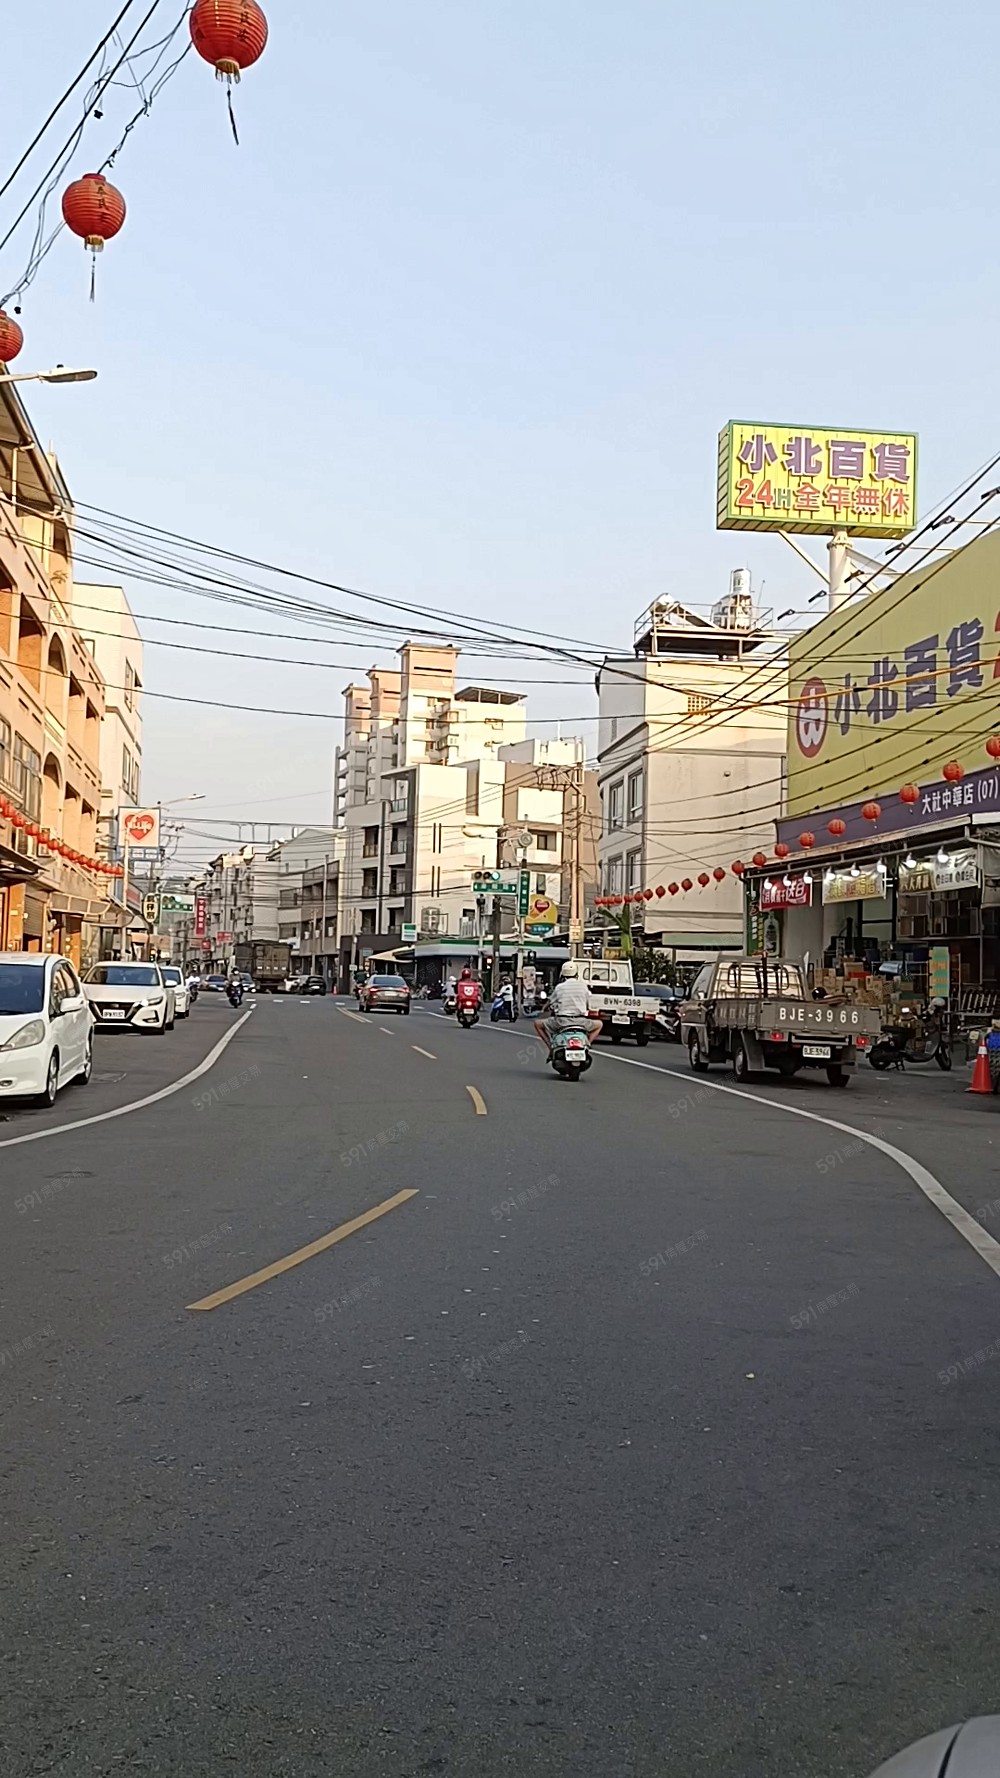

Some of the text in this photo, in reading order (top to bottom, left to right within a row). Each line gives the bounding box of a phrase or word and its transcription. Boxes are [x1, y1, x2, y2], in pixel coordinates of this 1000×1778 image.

[737, 434, 911, 484] 小北百貨
[736, 478, 910, 516] 24H全年無休
[834, 617, 984, 736] 小北百貨
[922, 775, 998, 815] 大社中華店 (07)
[603, 997, 641, 1006] BVN-6398
[779, 1007, 859, 1024] BJE-3966
